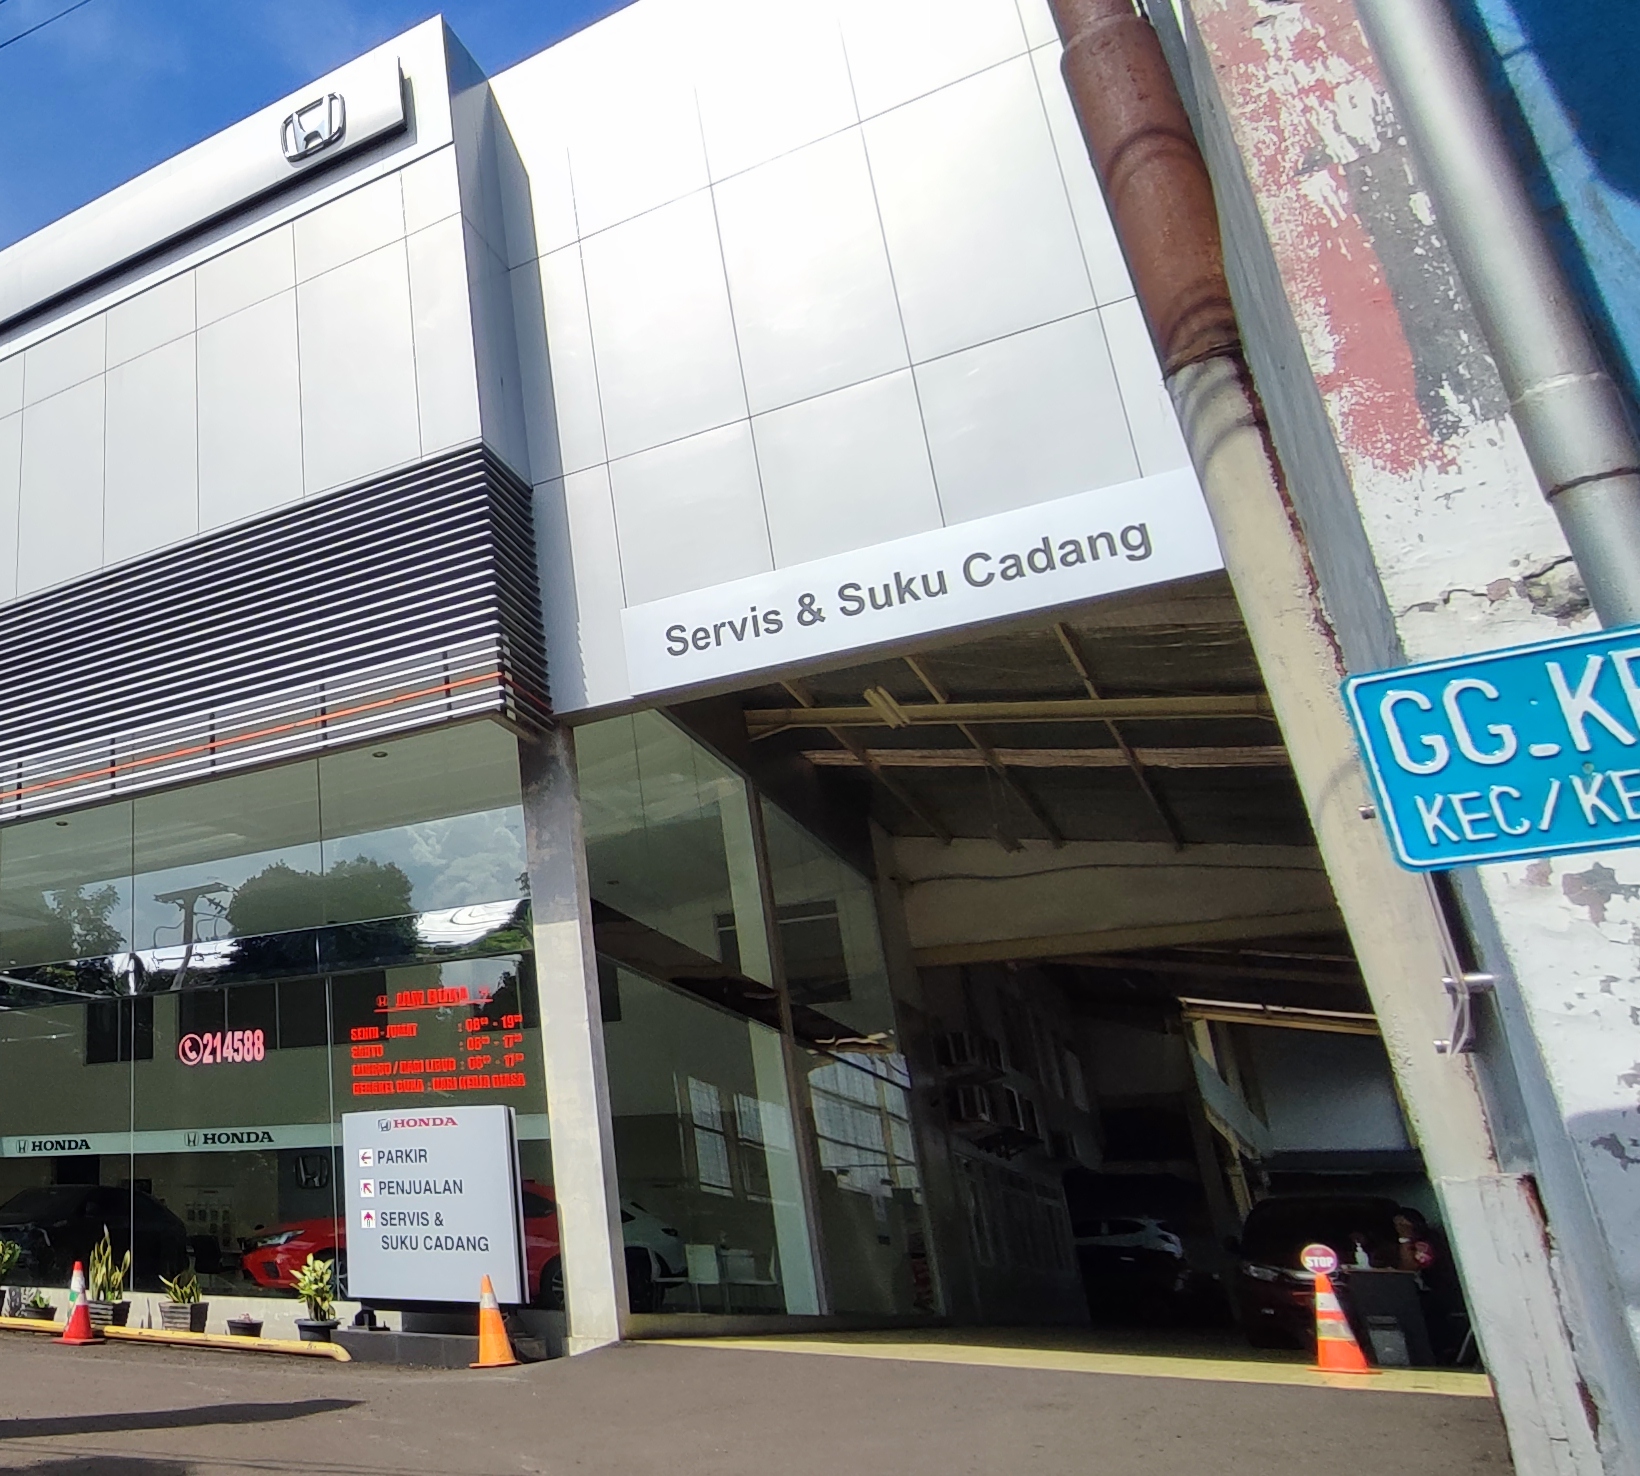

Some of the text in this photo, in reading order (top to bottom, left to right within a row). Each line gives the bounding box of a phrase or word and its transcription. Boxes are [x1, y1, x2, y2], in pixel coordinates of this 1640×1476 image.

[665, 521, 1153, 657] Servis & Suku Cadang
[202, 1029, 265, 1064] 214588
[393, 1116, 459, 1129] HONDA
[31, 1138, 91, 1151] HONDA
[202, 1131, 274, 1145] HONDA
[377, 1148, 428, 1165] PARKIR
[378, 1179, 464, 1196] PENJUALAN
[380, 1211, 444, 1227] SERVIS &
[381, 1234, 490, 1252] SUKU CADANG
[1305, 1256, 1333, 1268] STOP
